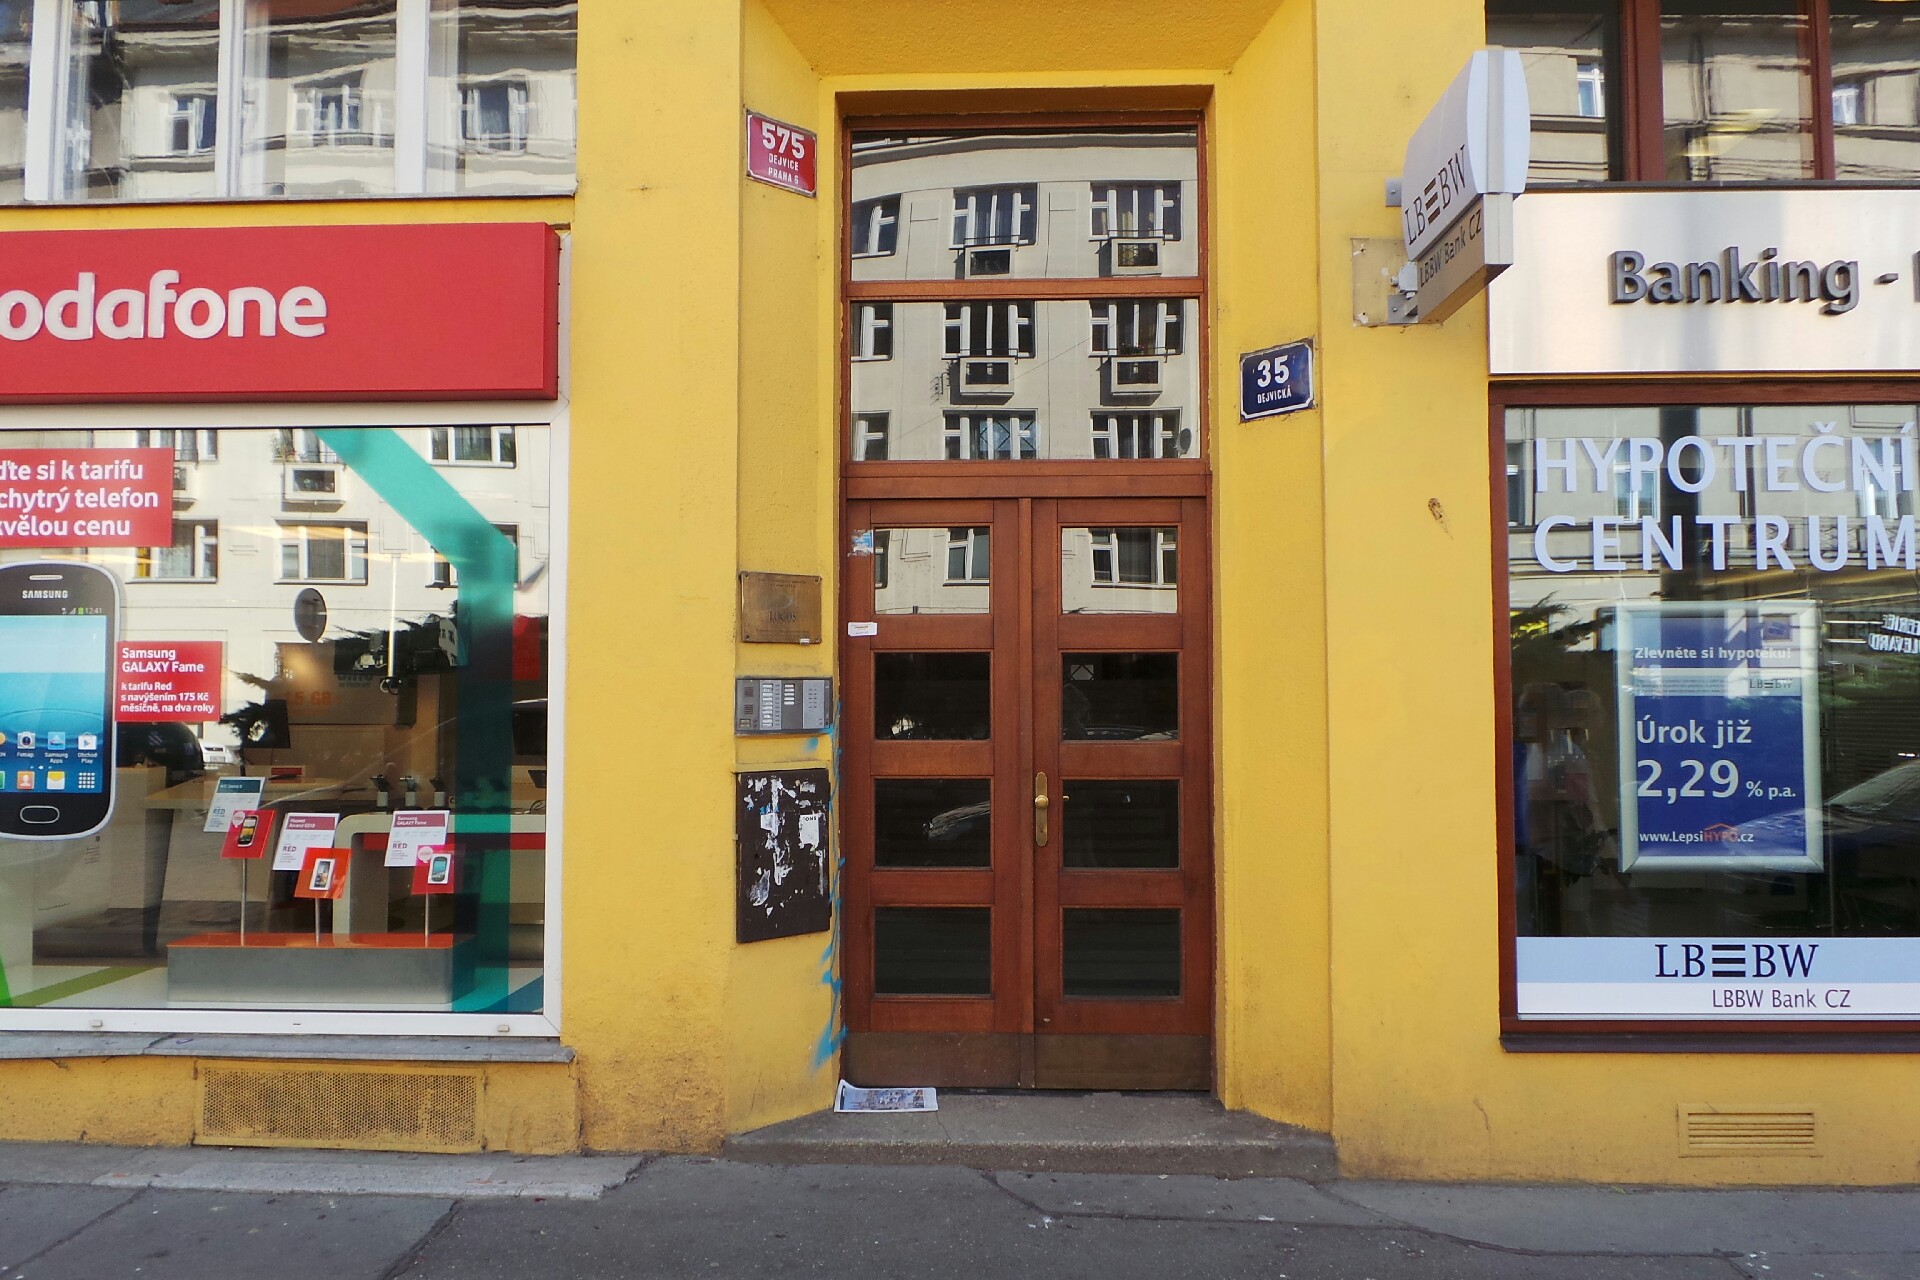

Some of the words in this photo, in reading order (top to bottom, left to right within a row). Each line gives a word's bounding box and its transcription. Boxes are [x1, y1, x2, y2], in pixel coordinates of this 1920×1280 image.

[761, 120, 805, 159] 575
[768, 152, 799, 171] DEJVICE
[768, 166, 792, 183] PRAHA
[1420, 248, 1442, 288] LBBW
[1444, 225, 1466, 265] Bank
[1469, 208, 1482, 241] CZ
[1608, 246, 1860, 315] Banking
[0, 269, 328, 342] odafone
[1257, 354, 1290, 388] 35
[1257, 384, 1292, 404] DEJVICKÁ
[1535, 421, 1915, 494] HYPOTEČNÍ
[36, 460, 56, 480] si
[61, 460, 75, 480] k
[80, 459, 144, 480] tarifu
[0, 486, 70, 513] chytrý
[75, 487, 159, 508] telefon
[0, 515, 68, 536] vělou
[73, 519, 131, 536] cenu
[1535, 514, 1916, 572] CENTRUM
[22, 590, 69, 599] SAMSUNG
[122, 648, 176, 660] Samsung
[1634, 646, 1698, 659] Zlevněte
[1701, 647, 1714, 659] si
[1718, 647, 1791, 661] hypotéku!
[122, 661, 170, 673] GALAXY
[171, 661, 204, 673] Fame
[121, 682, 127, 690] k
[128, 682, 153, 691] tarifu
[154, 682, 172, 690] Red
[127, 692, 177, 703] navýšením
[179, 692, 196, 701] 175
[197, 692, 209, 701] Kč
[174, 703, 192, 712] dva
[193, 703, 215, 714] roky
[1636, 715, 1706, 744] Úrok
[1713, 719, 1752, 749] již
[1636, 759, 1739, 804] 2,29
[1745, 780, 1764, 797] %
[1768, 785, 1796, 800] p.a.
[1712, 989, 1764, 1008] LBBW
[1772, 988, 1817, 1008] Bank
[1825, 989, 1851, 1008] CZ
